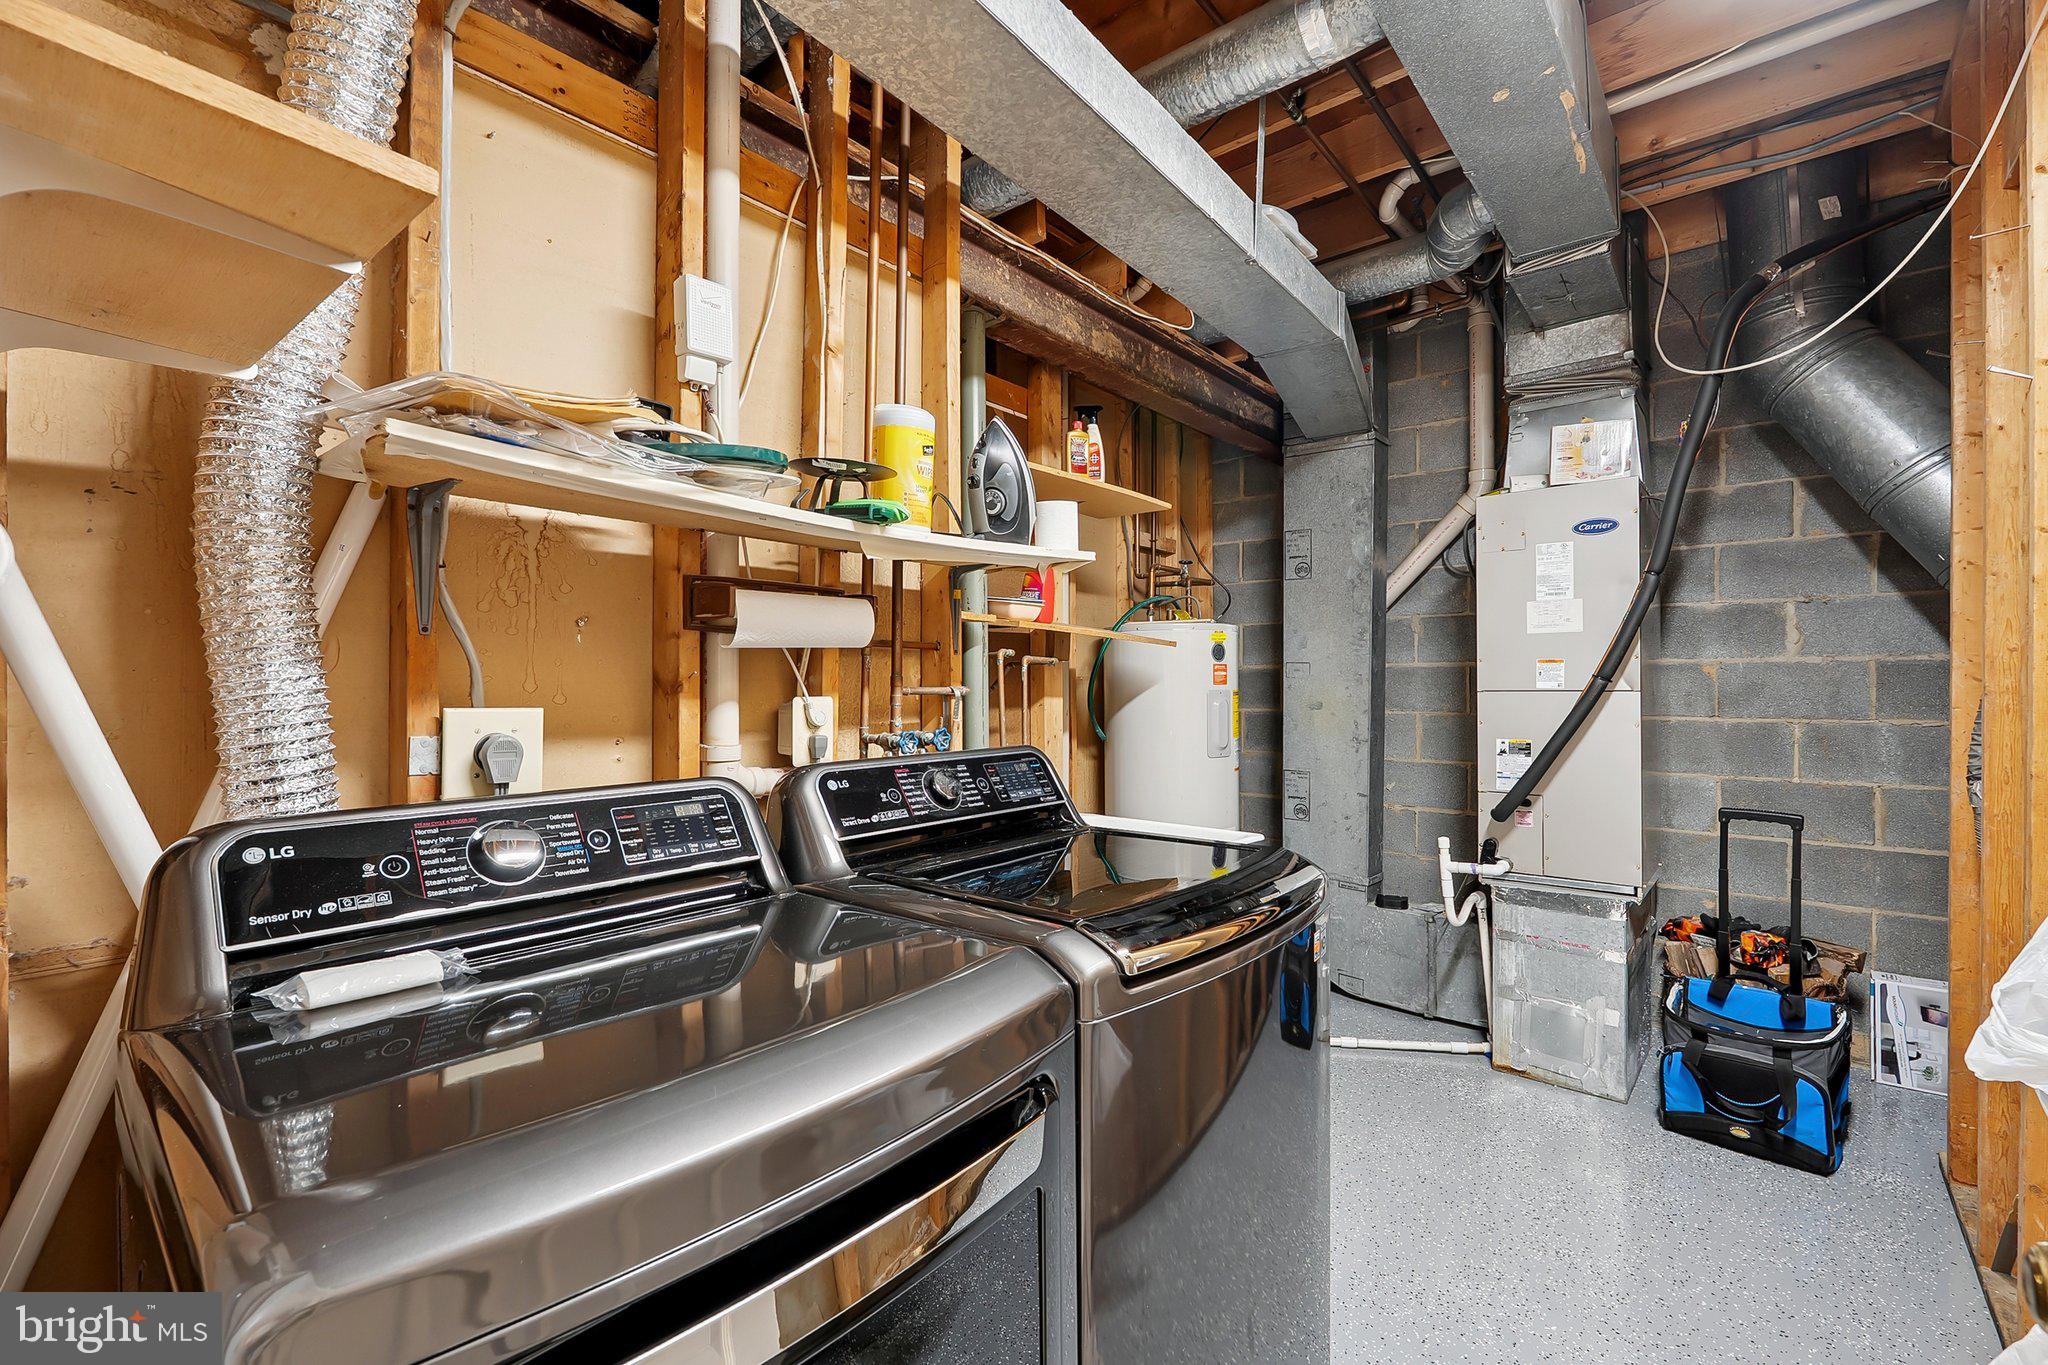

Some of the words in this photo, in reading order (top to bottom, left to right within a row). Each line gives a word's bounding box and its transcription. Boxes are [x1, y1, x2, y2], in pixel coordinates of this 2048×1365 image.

[1578, 522, 1613, 531] Carrier
[837, 779, 850, 789] LG
[415, 827, 439, 835] Normal
[417, 838, 438, 846] Heavy
[439, 836, 455, 844] Duty
[549, 839, 581, 848] Sportswear
[269, 845, 295, 860] LG
[419, 847, 447, 856] Bedding
[556, 851, 574, 859] Speed
[574, 849, 585, 857] Dry
[421, 857, 440, 866] Small
[576, 857, 587, 865] Dry
[423, 864, 467, 876] Anti-Bacterial
[554, 867, 590, 877] Downloaded
[425, 878, 447, 887] Steam
[427, 888, 448, 898] Steam
[248, 911, 290, 926] Sensor
[292, 908, 313, 920] Dry
